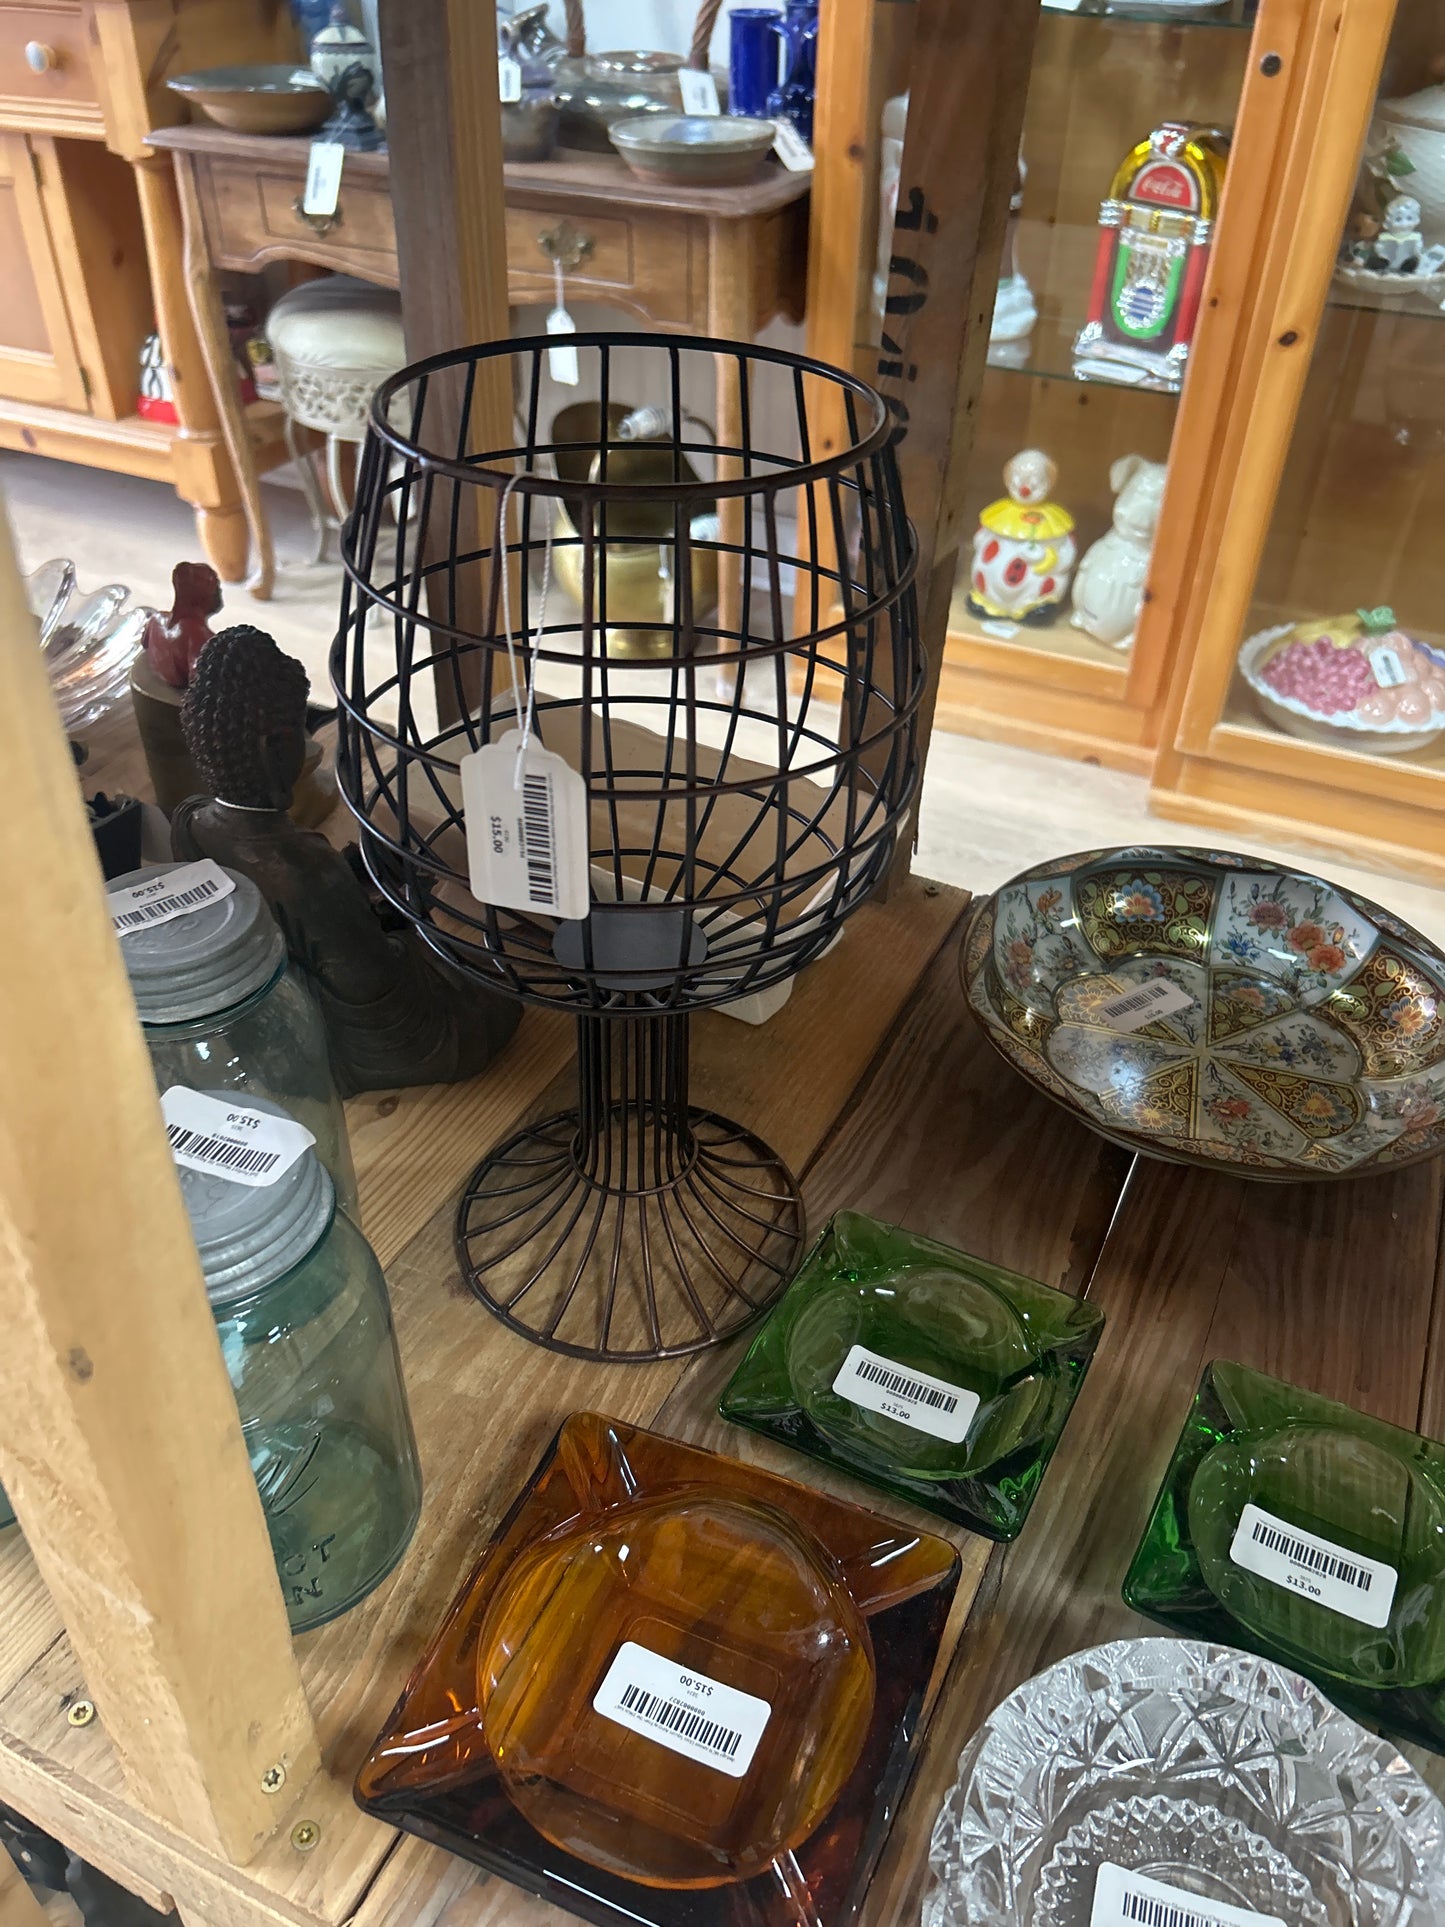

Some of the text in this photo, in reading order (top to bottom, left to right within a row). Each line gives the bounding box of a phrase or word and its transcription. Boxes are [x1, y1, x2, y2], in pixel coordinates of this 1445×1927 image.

[490, 815, 504, 853] $15.00
[226, 1113, 261, 1130] $15.00
[880, 1402, 911, 1420] $13.00
[1285, 1574, 1322, 1596] $13.00
[679, 1675, 714, 1696] $15.00
